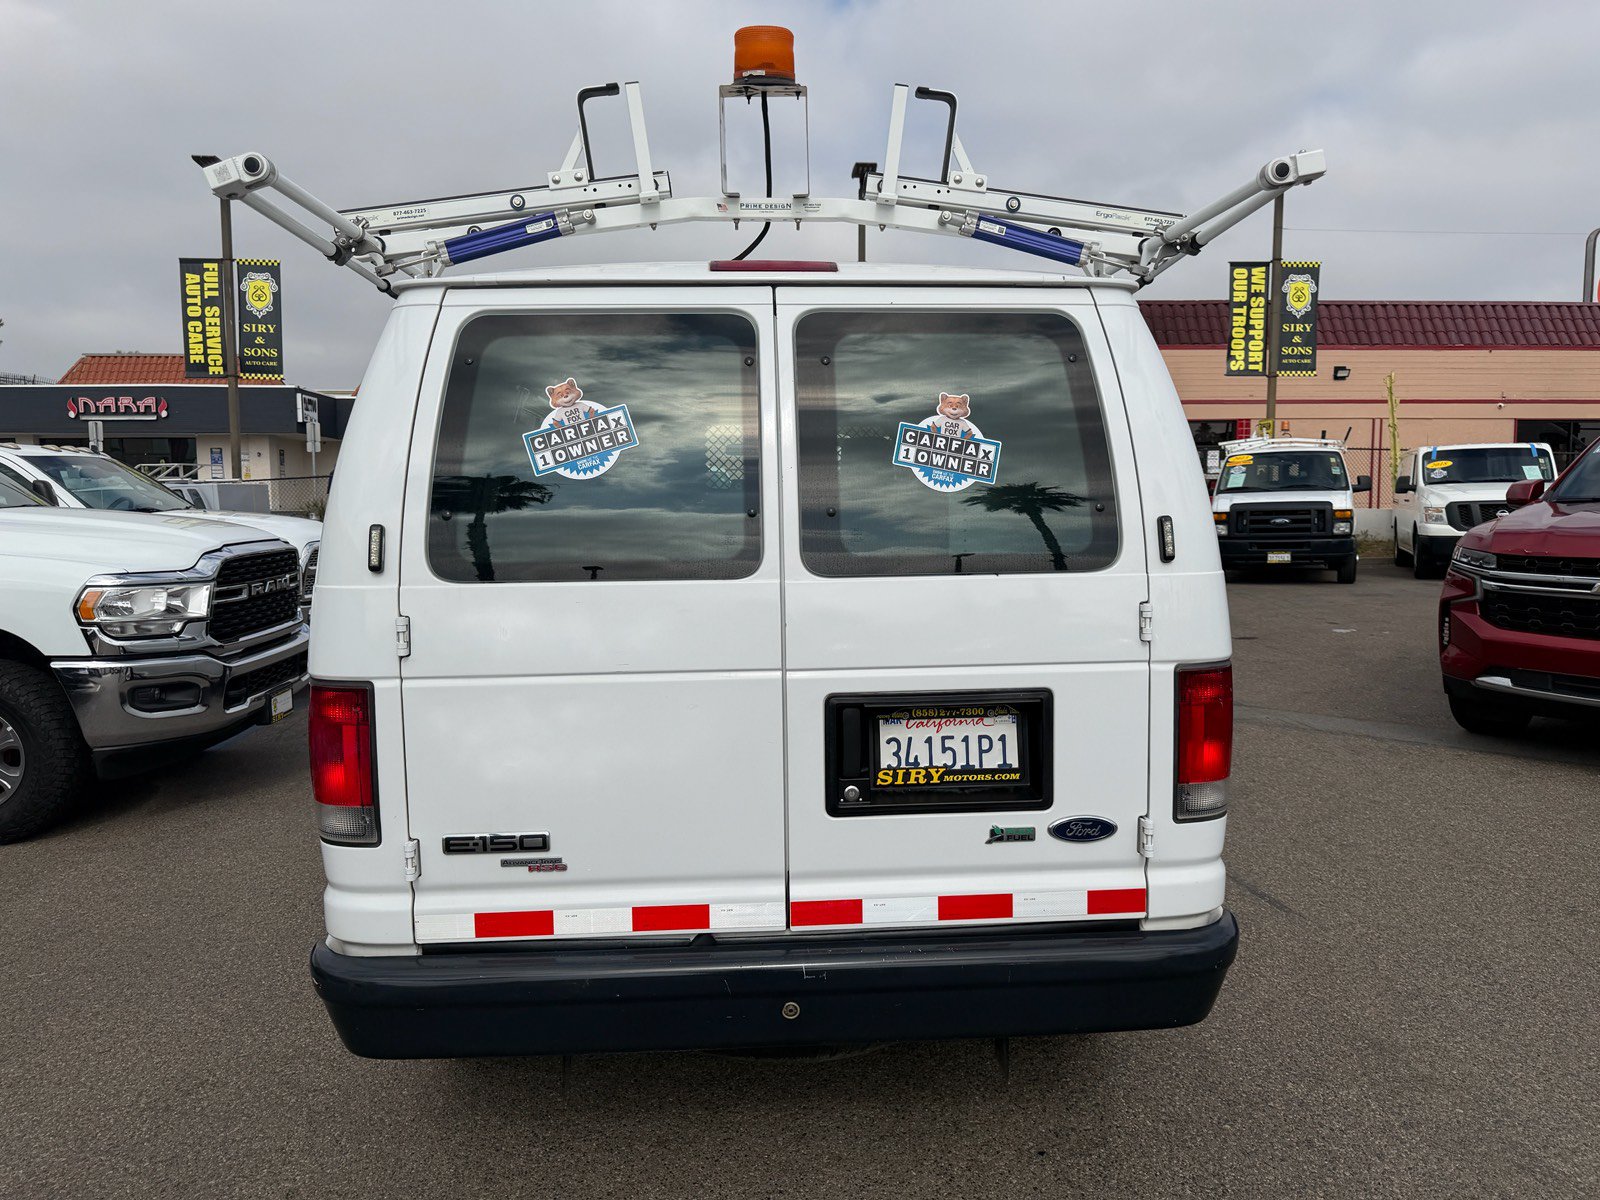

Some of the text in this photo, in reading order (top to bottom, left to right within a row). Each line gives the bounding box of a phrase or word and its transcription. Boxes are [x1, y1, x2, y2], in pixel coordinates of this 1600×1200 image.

[185, 273, 205, 364] AUTO CARE
[203, 262, 224, 375] FULL SERVICE
[1229, 268, 1248, 371] OUR TROOPS
[1248, 266, 1266, 372] WE SUPPORT
[243, 323, 276, 333] SIRY
[1282, 323, 1313, 332] SIRY
[254, 336, 265, 344] &
[243, 347, 278, 357] SONS
[1281, 346, 1313, 355] SONS
[564, 407, 580, 417] CAR
[566, 414, 582, 424] FOX
[534, 415, 622, 450] CARFAX
[944, 421, 960, 430] CAR
[944, 427, 958, 436] FOX
[539, 431, 629, 467] 1 OWNER
[905, 431, 992, 461] CARFAX
[902, 447, 989, 476] 1 OWNER
[251, 575, 290, 596] RAM
[912, 708, 938, 717] (858)
[906, 716, 994, 733] California
[885, 734, 1013, 769] 34151P1
[876, 768, 1020, 785] SIRY MOTORS.COM
[1065, 821, 1101, 837] Ford
